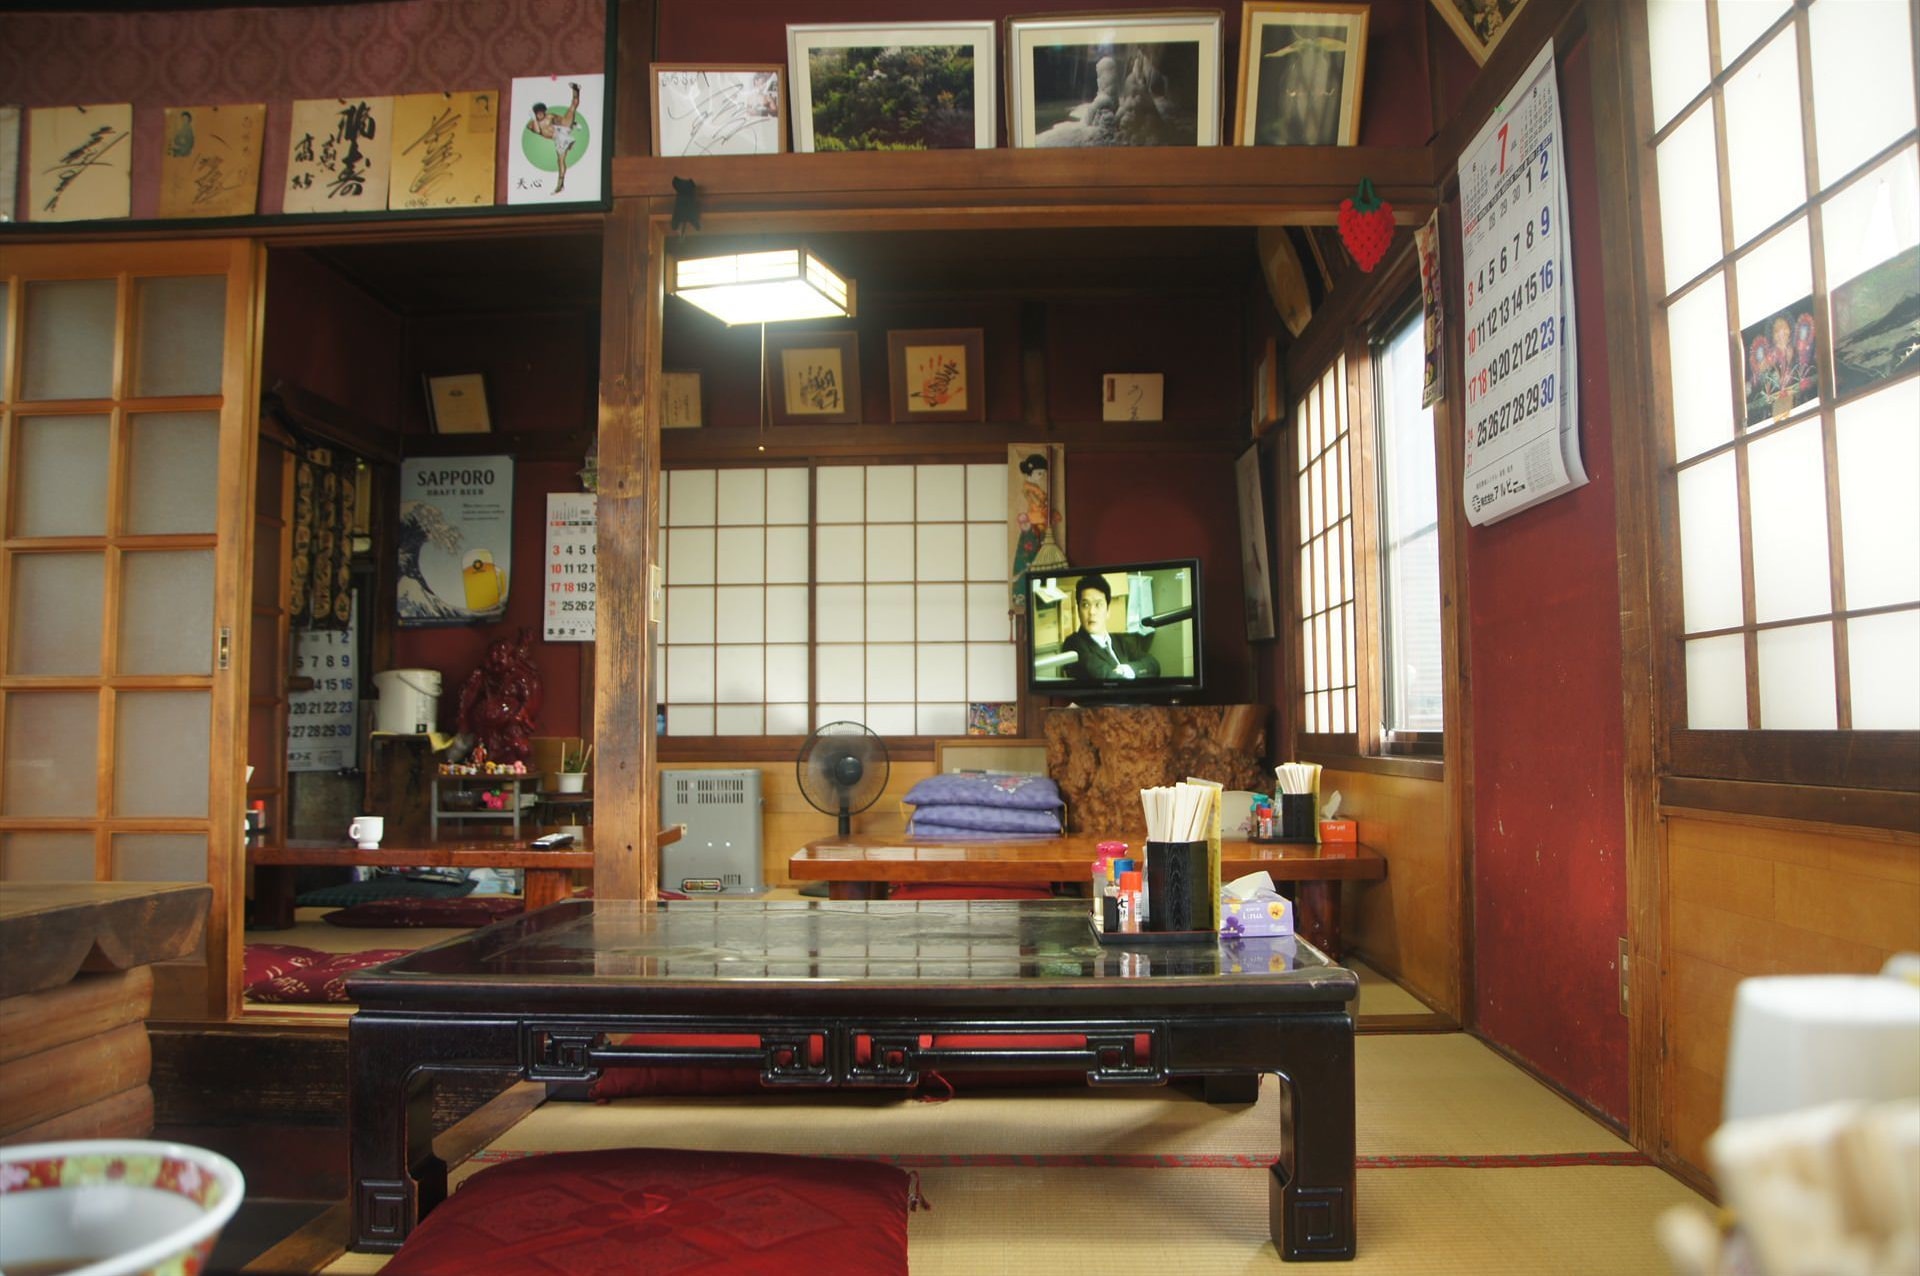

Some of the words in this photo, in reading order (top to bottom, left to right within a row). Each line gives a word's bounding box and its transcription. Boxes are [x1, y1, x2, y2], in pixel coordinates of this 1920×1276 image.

[1497, 122, 1508, 175] 7
[1512, 184, 1521, 204] 30
[1525, 166, 1532, 194] 1
[1540, 150, 1549, 182] 2
[1468, 281, 1474, 307] 3
[1478, 270, 1484, 294] 4
[1488, 258, 1495, 285] 5
[1500, 246, 1507, 274] 6
[1513, 233, 1521, 262] 7
[1526, 220, 1534, 249] 8
[1541, 205, 1550, 236] 9
[1468, 327, 1476, 356] 10
[1477, 318, 1485, 346] 11
[1487, 307, 1498, 336] 12
[1499, 296, 1510, 326] 13
[1512, 285, 1523, 316] 14
[1525, 272, 1537, 305] 15
[1540, 259, 1553, 293] 16
[1469, 376, 1477, 405] 17
[1478, 368, 1487, 396] 18
[1488, 359, 1498, 387] 19
[1499, 349, 1510, 380] 20
[1512, 338, 1523, 371] 21
[1525, 328, 1539, 361] 22
[1540, 316, 1555, 351] 23
[1477, 418, 1487, 447] 25
[1488, 410, 1499, 441] 26
[1500, 401, 1511, 433] 27
[1512, 393, 1525, 425] 28
[1526, 384, 1540, 417] 29
[1540, 374, 1555, 408] 30
[417, 469, 495, 487] SAPPORO
[553, 544, 561, 556] 3
[566, 544, 573, 555] 4
[579, 544, 587, 555] 5
[551, 564, 562, 574] 10
[564, 564, 574, 574] 11
[577, 564, 588, 574] 12
[551, 582, 561, 592] 17
[564, 582, 574, 592] 18
[577, 582, 588, 592] 19
[562, 601, 574, 611] 25
[575, 601, 588, 611] 26
[588, 601, 596, 611] 2
[326, 632, 333, 644] 1
[340, 632, 350, 644] 2
[311, 656, 319, 667] 7
[326, 655, 334, 667] 8
[341, 655, 350, 667] 9
[326, 679, 338, 690] 15
[340, 678, 352, 690] 16
[293, 702, 307, 714] 20
[309, 702, 321, 714] 21
[324, 701, 337, 714] 22
[339, 701, 352, 713] 23
[293, 726, 305, 737] 27
[308, 725, 321, 737] 28
[323, 725, 336, 737] 29
[337, 725, 352, 737] 30
